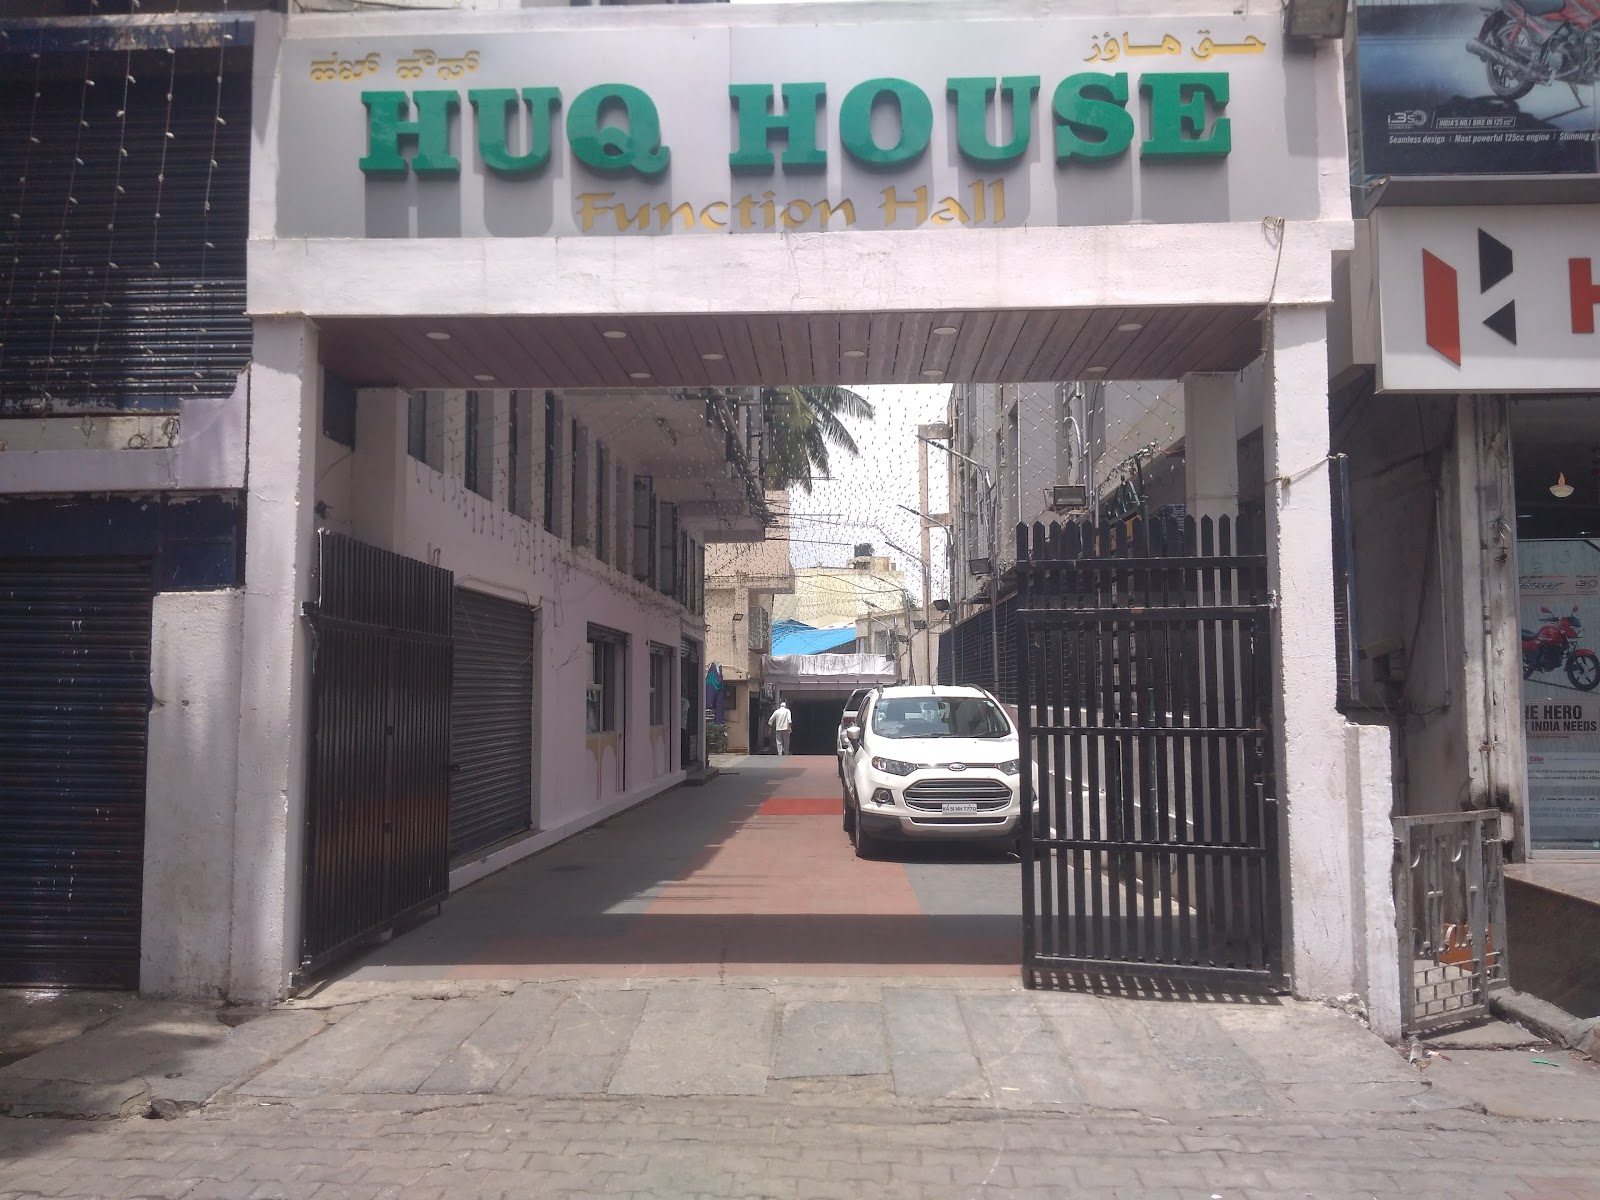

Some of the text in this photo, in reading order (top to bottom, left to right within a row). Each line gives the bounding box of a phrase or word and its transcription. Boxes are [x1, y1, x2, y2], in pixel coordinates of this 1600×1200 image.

[1191, 30, 1266, 62] حق
[359, 71, 1232, 178] HUQ HOUSE
[1487, 118, 1493, 126] IN
[1494, 118, 1503, 126] 125
[1389, 135, 1421, 144] Seamless
[1422, 134, 1446, 145] design
[1454, 134, 1472, 143] Most
[1472, 133, 1503, 144] powerful
[1505, 133, 1525, 142] 125cc
[1526, 132, 1550, 143] engine
[1560, 132, 1590, 142] Stunning
[576, 178, 1007, 231] Function Hall
[1543, 704, 1583, 720] HERO
[1531, 721, 1560, 732] INDIA
[1563, 720, 1597, 732] NEEDS
